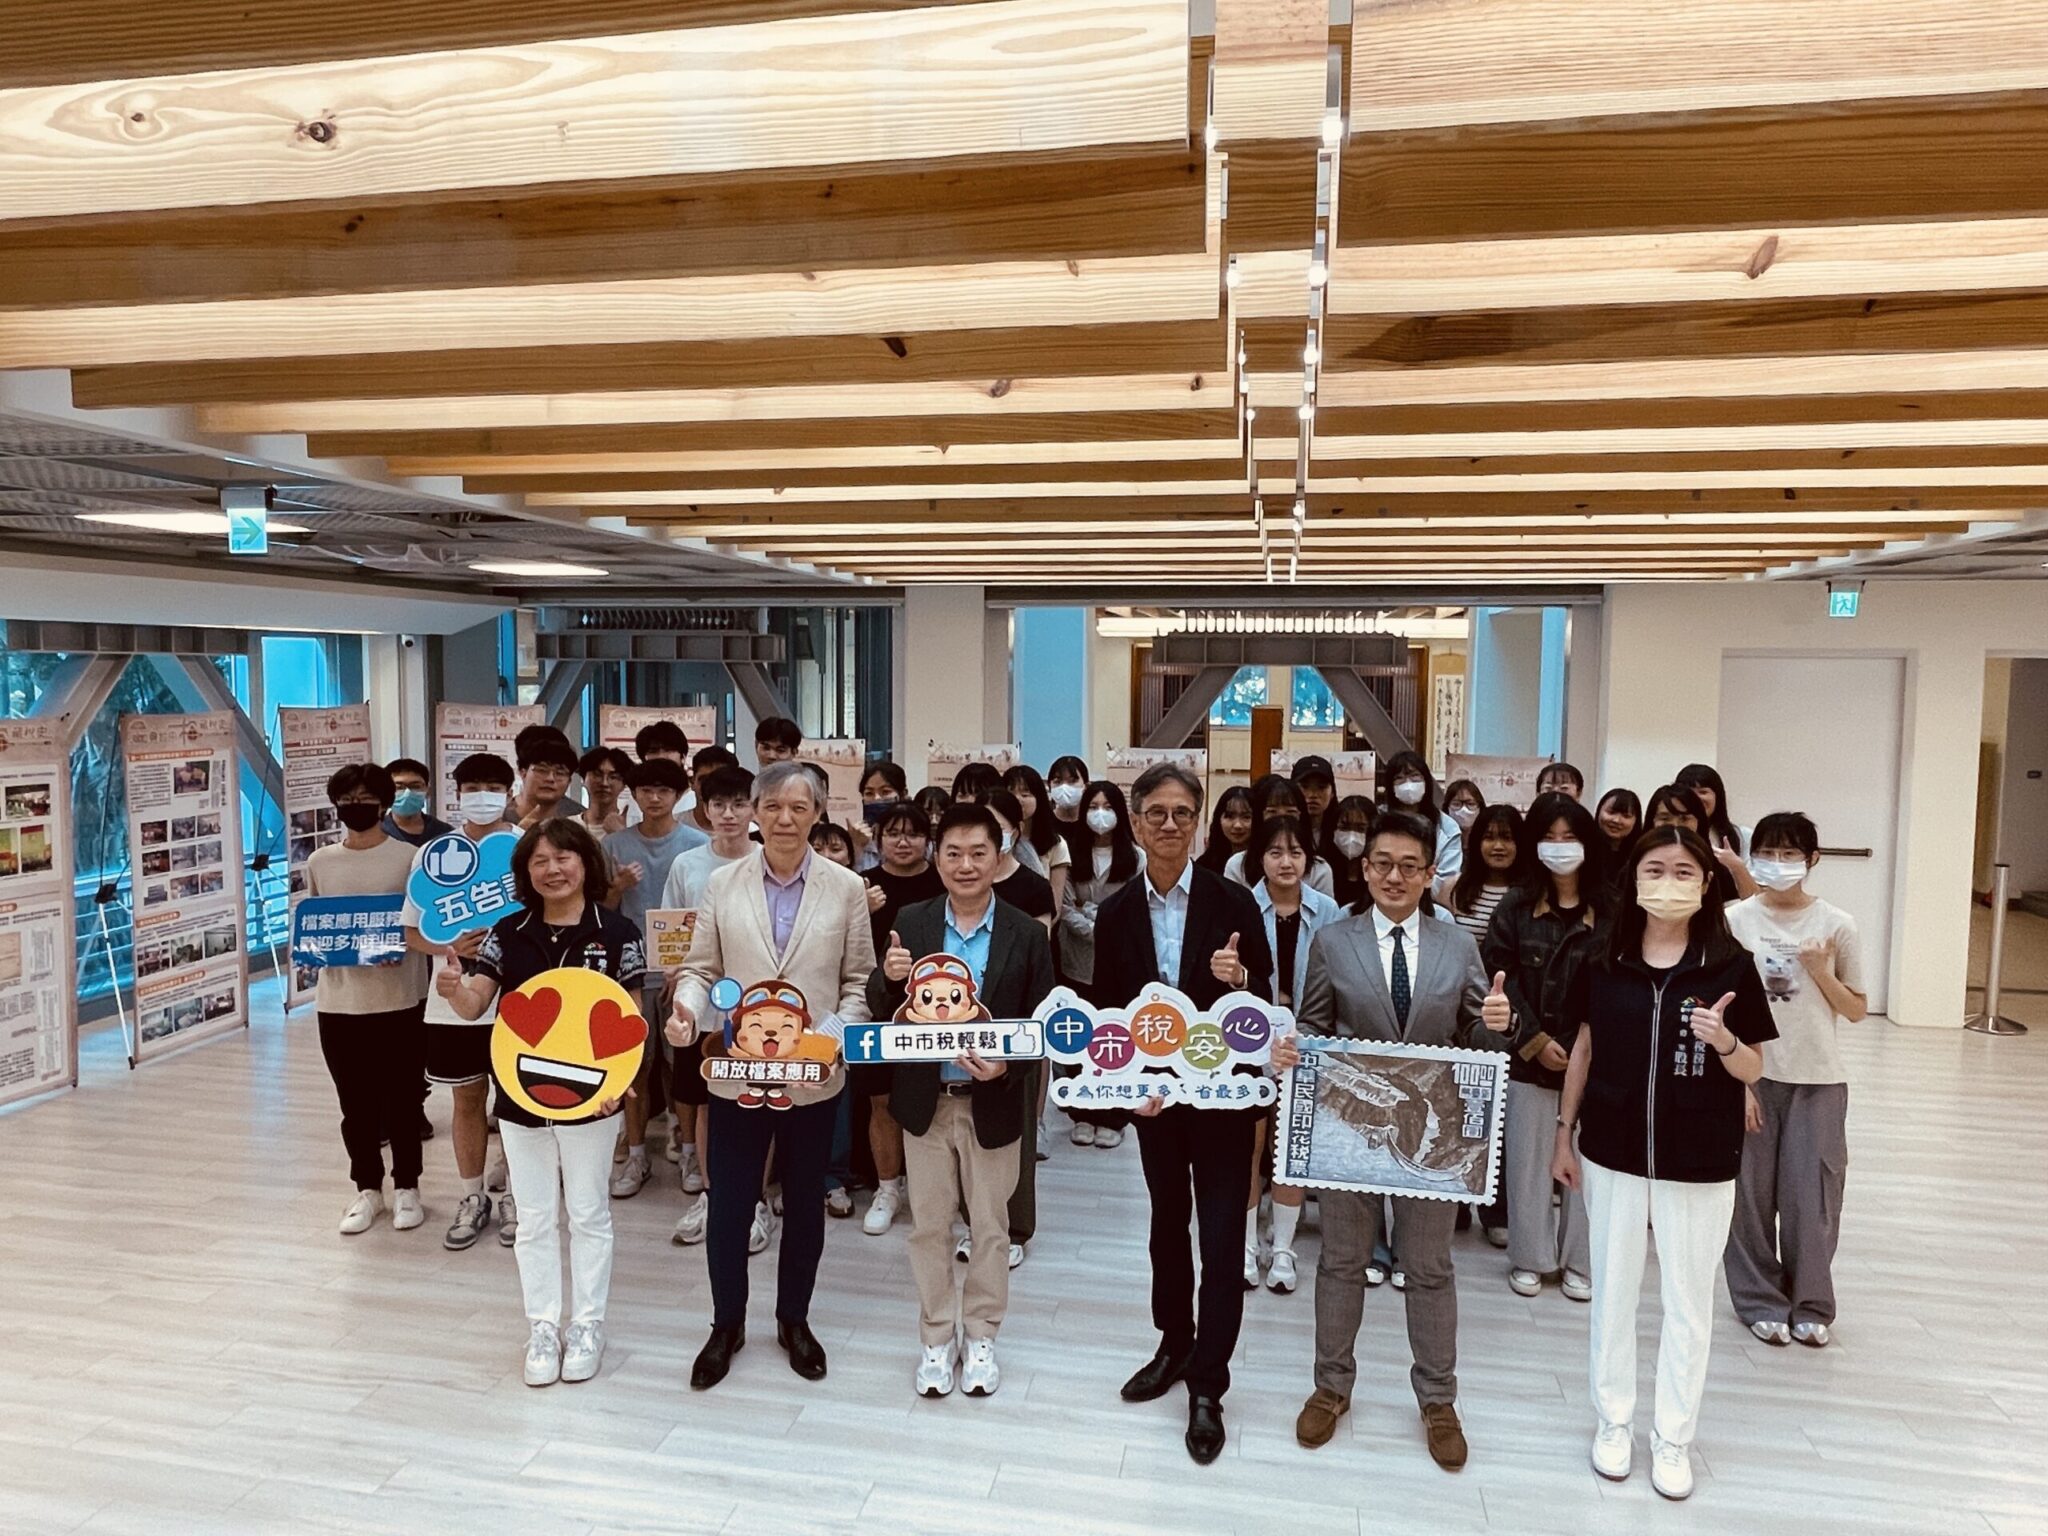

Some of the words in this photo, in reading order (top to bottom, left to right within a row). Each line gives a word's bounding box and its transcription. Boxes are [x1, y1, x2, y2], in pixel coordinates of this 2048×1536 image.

[895, 1031, 997, 1051] 中市稅輕鬆
[1054, 1013, 1265, 1062] 中市稅安心
[711, 1060, 820, 1082] 開放檔案應用
